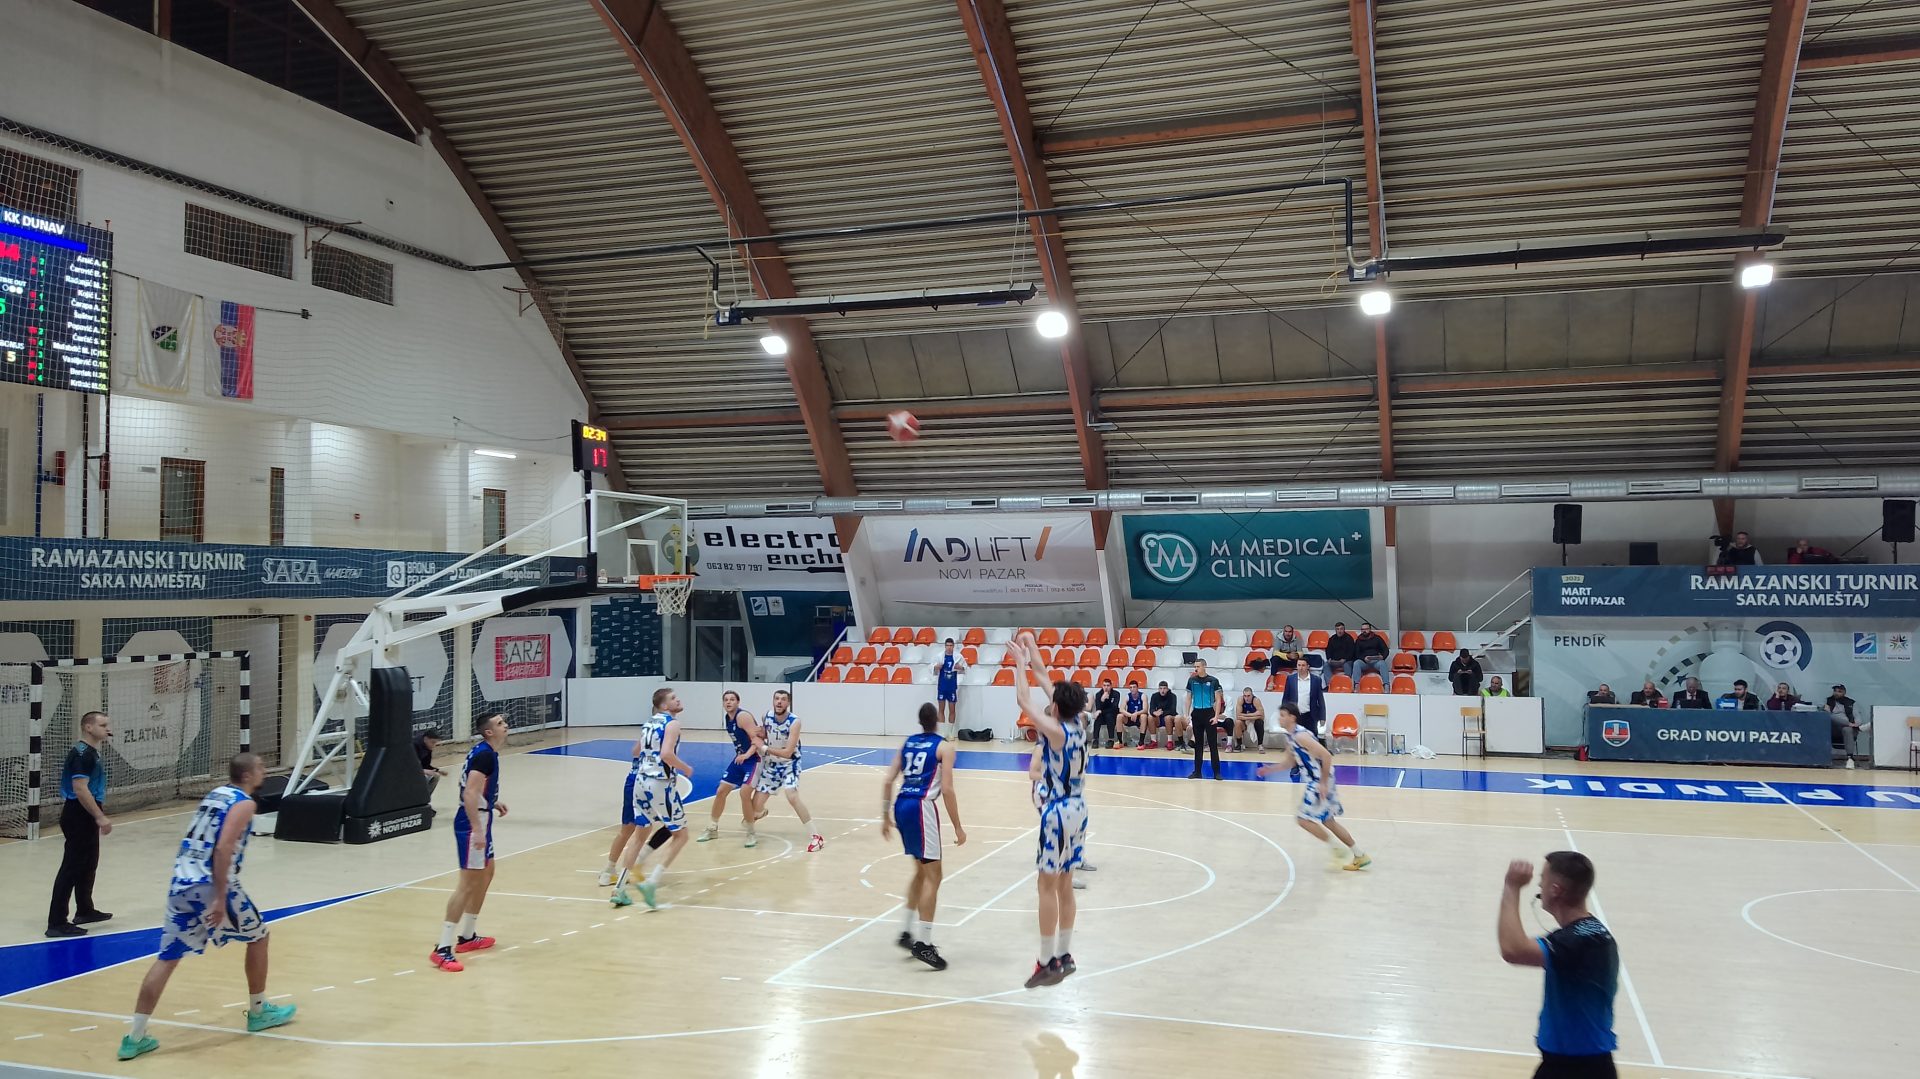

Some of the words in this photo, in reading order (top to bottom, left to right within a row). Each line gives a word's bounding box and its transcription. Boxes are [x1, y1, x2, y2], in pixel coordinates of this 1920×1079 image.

[4, 211, 20, 225] KK
[22, 215, 65, 235] DUNAV
[14, 278, 27, 287] OUT
[7, 350, 17, 362] 5
[592, 448, 608, 467] 17
[1210, 539, 1231, 557] M
[1240, 538, 1351, 557] MEDICAL
[31, 547, 174, 569] RAMAZANSKI
[178, 551, 246, 571] TURNIR
[706, 562, 722, 571] 063
[724, 563, 735, 571] 82
[737, 563, 746, 571] 97
[749, 563, 763, 572] 797
[260, 557, 322, 585] SARA
[406, 562, 436, 574] BRONJA
[938, 568, 972, 580] NOVI
[979, 568, 1026, 580] PAZAR
[1211, 559, 1291, 578] CLINIC
[80, 573, 126, 588] SARA
[129, 571, 206, 591] NAMEŠTAJ
[1690, 575, 1831, 590] RAMAZANSKI
[1836, 575, 1919, 590] TURNIR
[1561, 587, 1593, 596] MART
[1736, 594, 1781, 606] SARA
[1784, 591, 1870, 608] NAMEŠTAJ
[1561, 597, 1589, 606] NOVI
[1591, 597, 1626, 606] PAZAR
[502, 640, 543, 664] SARA
[124, 726, 169, 744] ZLATNA
[1657, 729, 1702, 741] GRAD
[1706, 730, 1746, 743] NOVI
[1749, 731, 1802, 744] PAZAR
[903, 751, 928, 776] 19
[1524, 777, 1845, 801] PENDIK
[382, 823, 400, 834] NOVI
[400, 818, 422, 830] PAZAR
